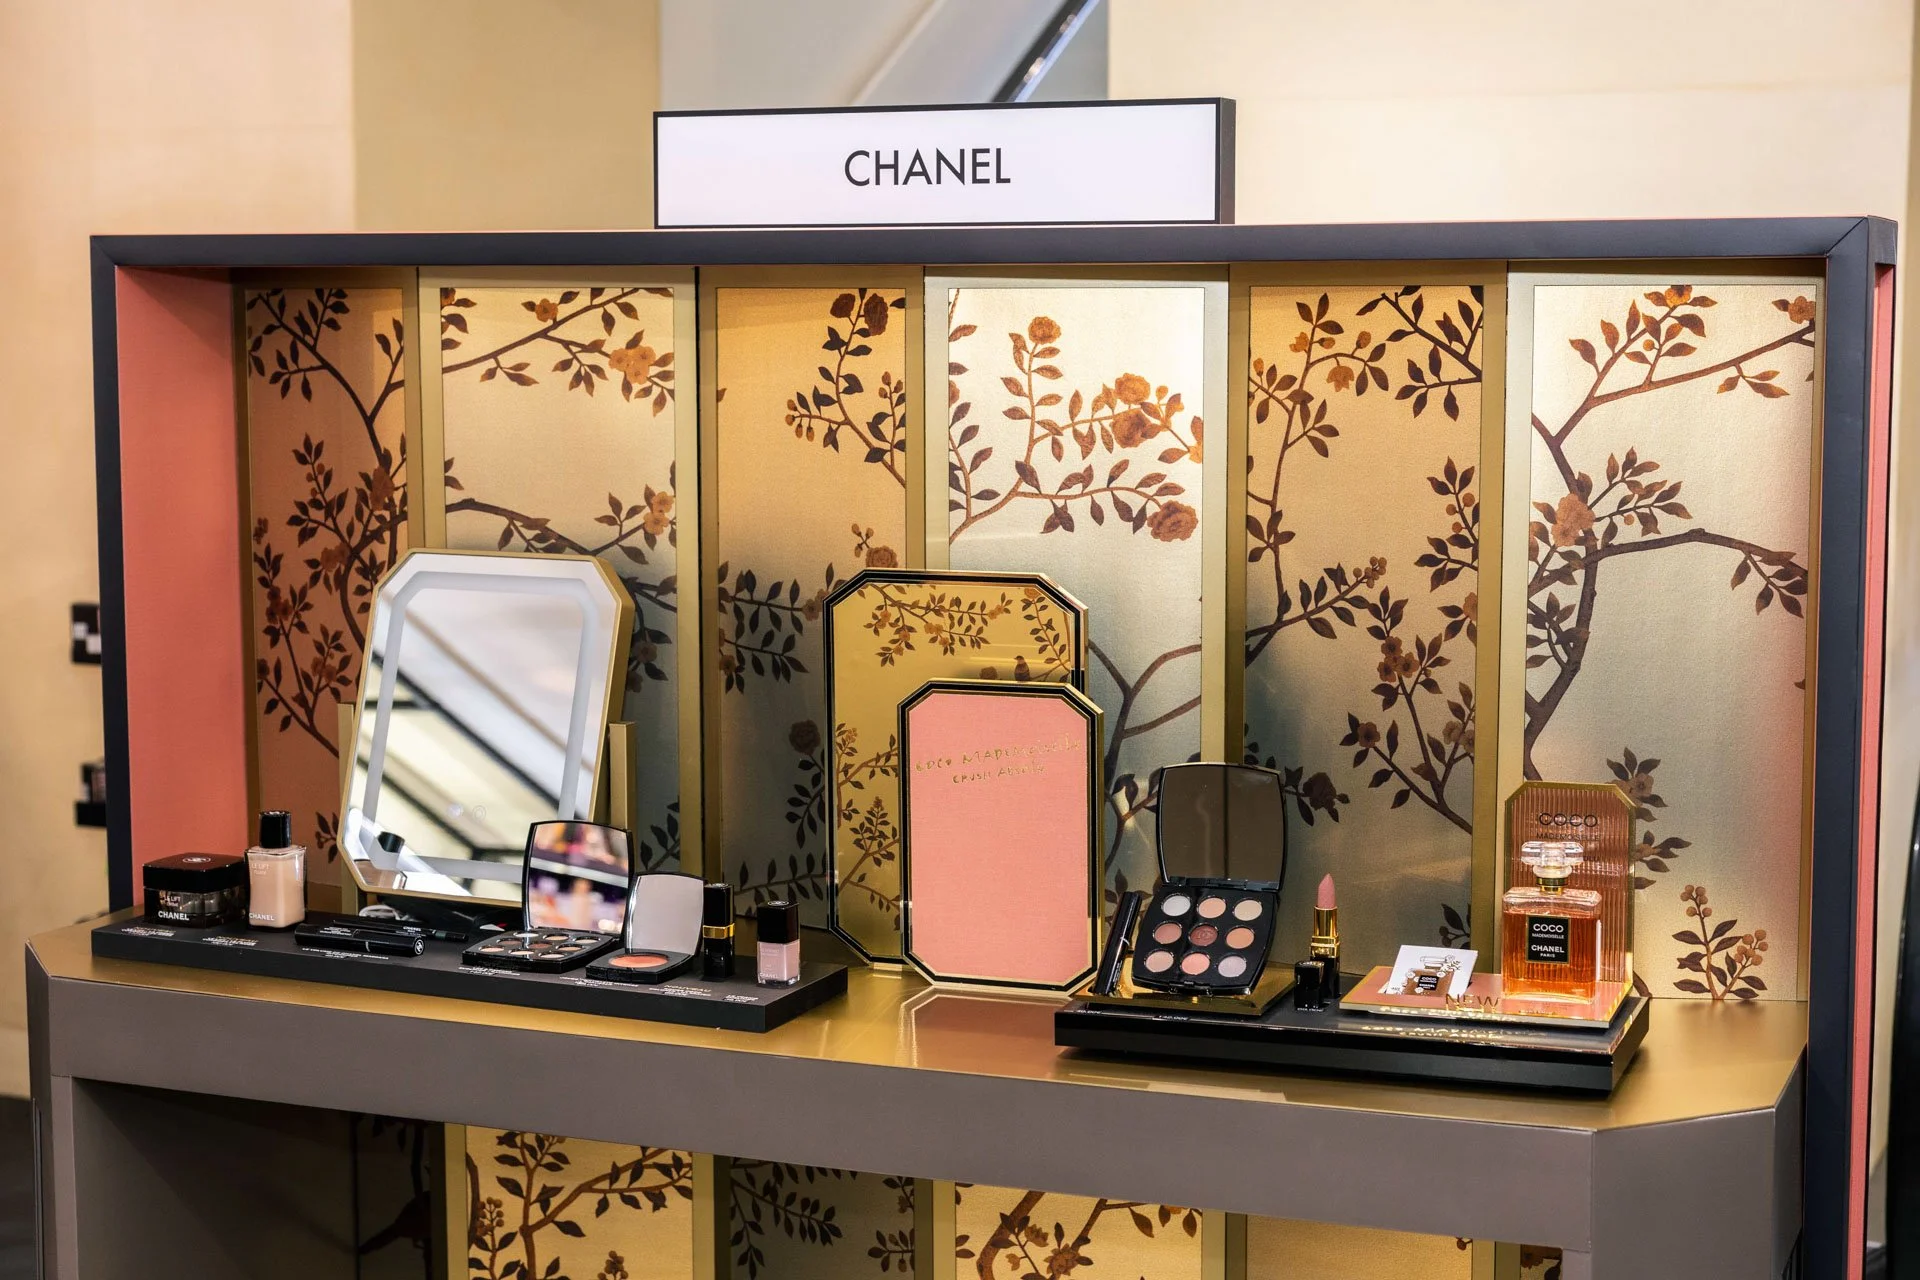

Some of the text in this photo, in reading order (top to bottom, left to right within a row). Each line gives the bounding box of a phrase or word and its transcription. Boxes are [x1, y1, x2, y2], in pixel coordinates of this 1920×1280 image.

[845, 148, 1011, 187] CHANEL
[1539, 812, 1598, 828] COCO
[1536, 832, 1601, 842] MADEMOISELLE
[158, 910, 190, 921] CHANEL
[249, 912, 275, 921] CHANEL
[1533, 923, 1564, 933] COCO
[1531, 944, 1565, 953] CHANEL
[1445, 993, 1499, 1013] NEW
